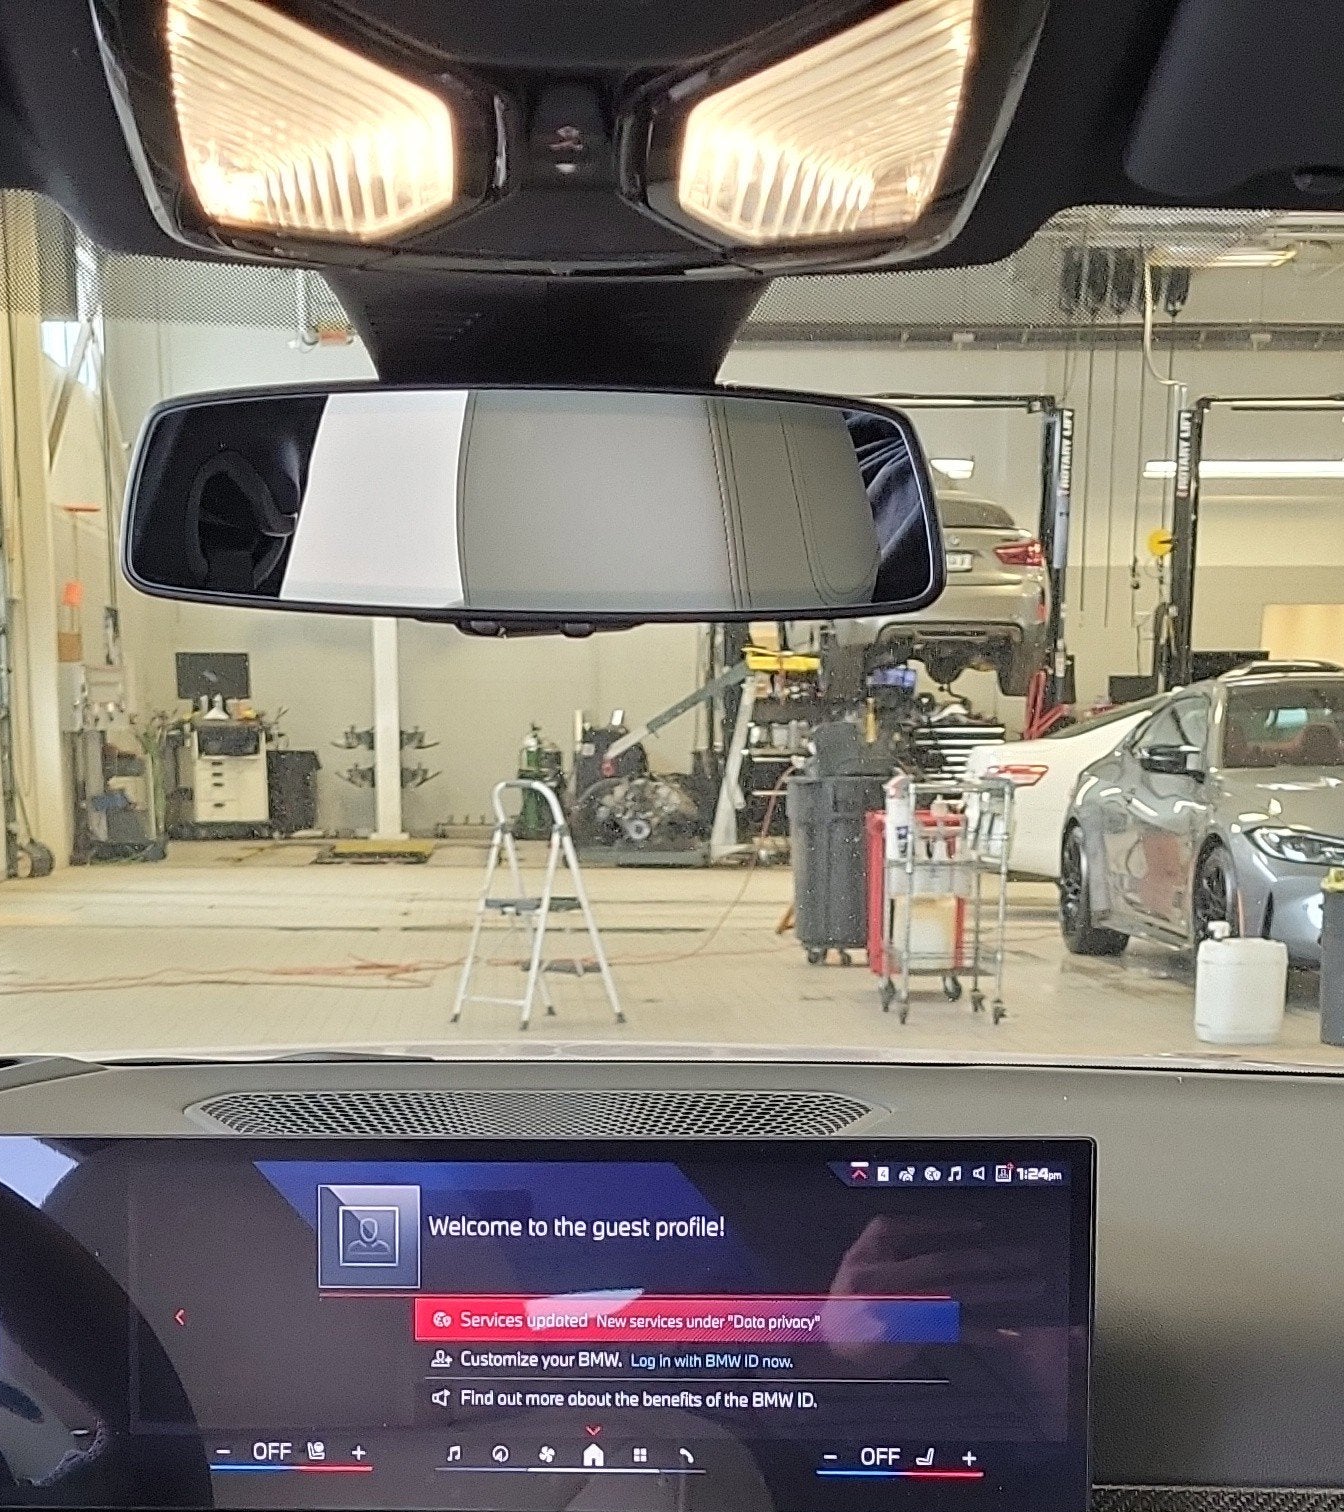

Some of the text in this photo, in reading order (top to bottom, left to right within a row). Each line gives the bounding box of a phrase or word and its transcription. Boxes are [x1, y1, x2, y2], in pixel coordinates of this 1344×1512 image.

[428, 1214, 725, 1241] Welcome to the guest profile!
[460, 1311, 821, 1332] Services updated New services under "Data privacy"
[460, 1350, 794, 1371] Customize your BMW. Log in with BMW ID now.
[460, 1389, 818, 1409] Find out more about the benefits of the BMW ID.
[252, 1442, 292, 1462] OFF
[860, 1447, 901, 1466] OFF
